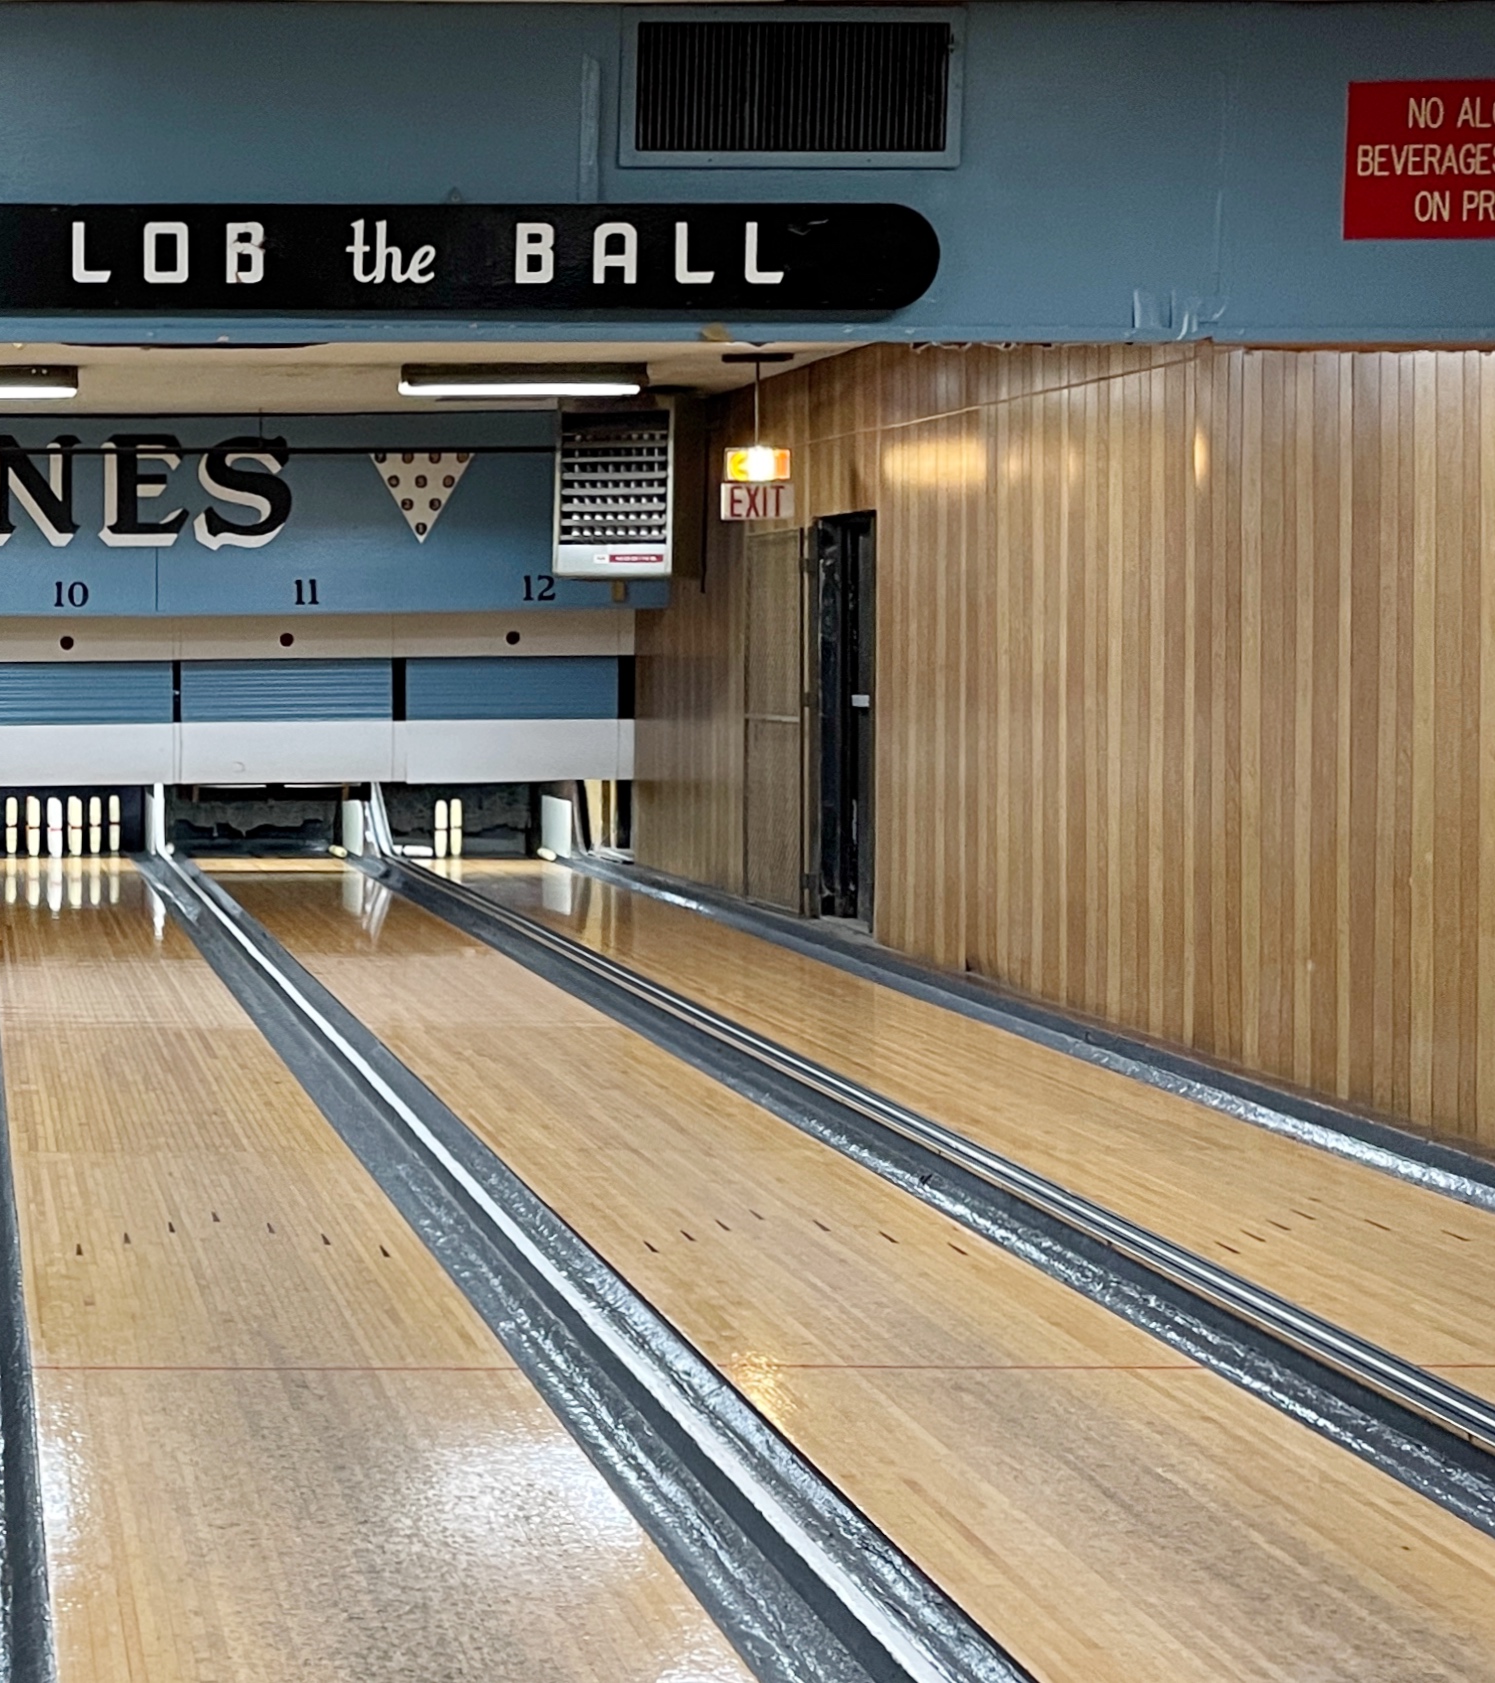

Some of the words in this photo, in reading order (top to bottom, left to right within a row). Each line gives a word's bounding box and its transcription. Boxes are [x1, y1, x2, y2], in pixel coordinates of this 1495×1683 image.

[1408, 96, 1445, 129] NO
[1456, 95, 1495, 129] AL
[1356, 142, 1495, 177] BEVERAGE
[1414, 190, 1450, 223] ON
[71, 221, 265, 285] LOB
[345, 218, 436, 285] the
[514, 221, 785, 285] BALL
[730, 485, 786, 518] EXIT
[54, 581, 89, 607] 10
[294, 578, 320, 606] 11
[523, 574, 556, 602] 12
